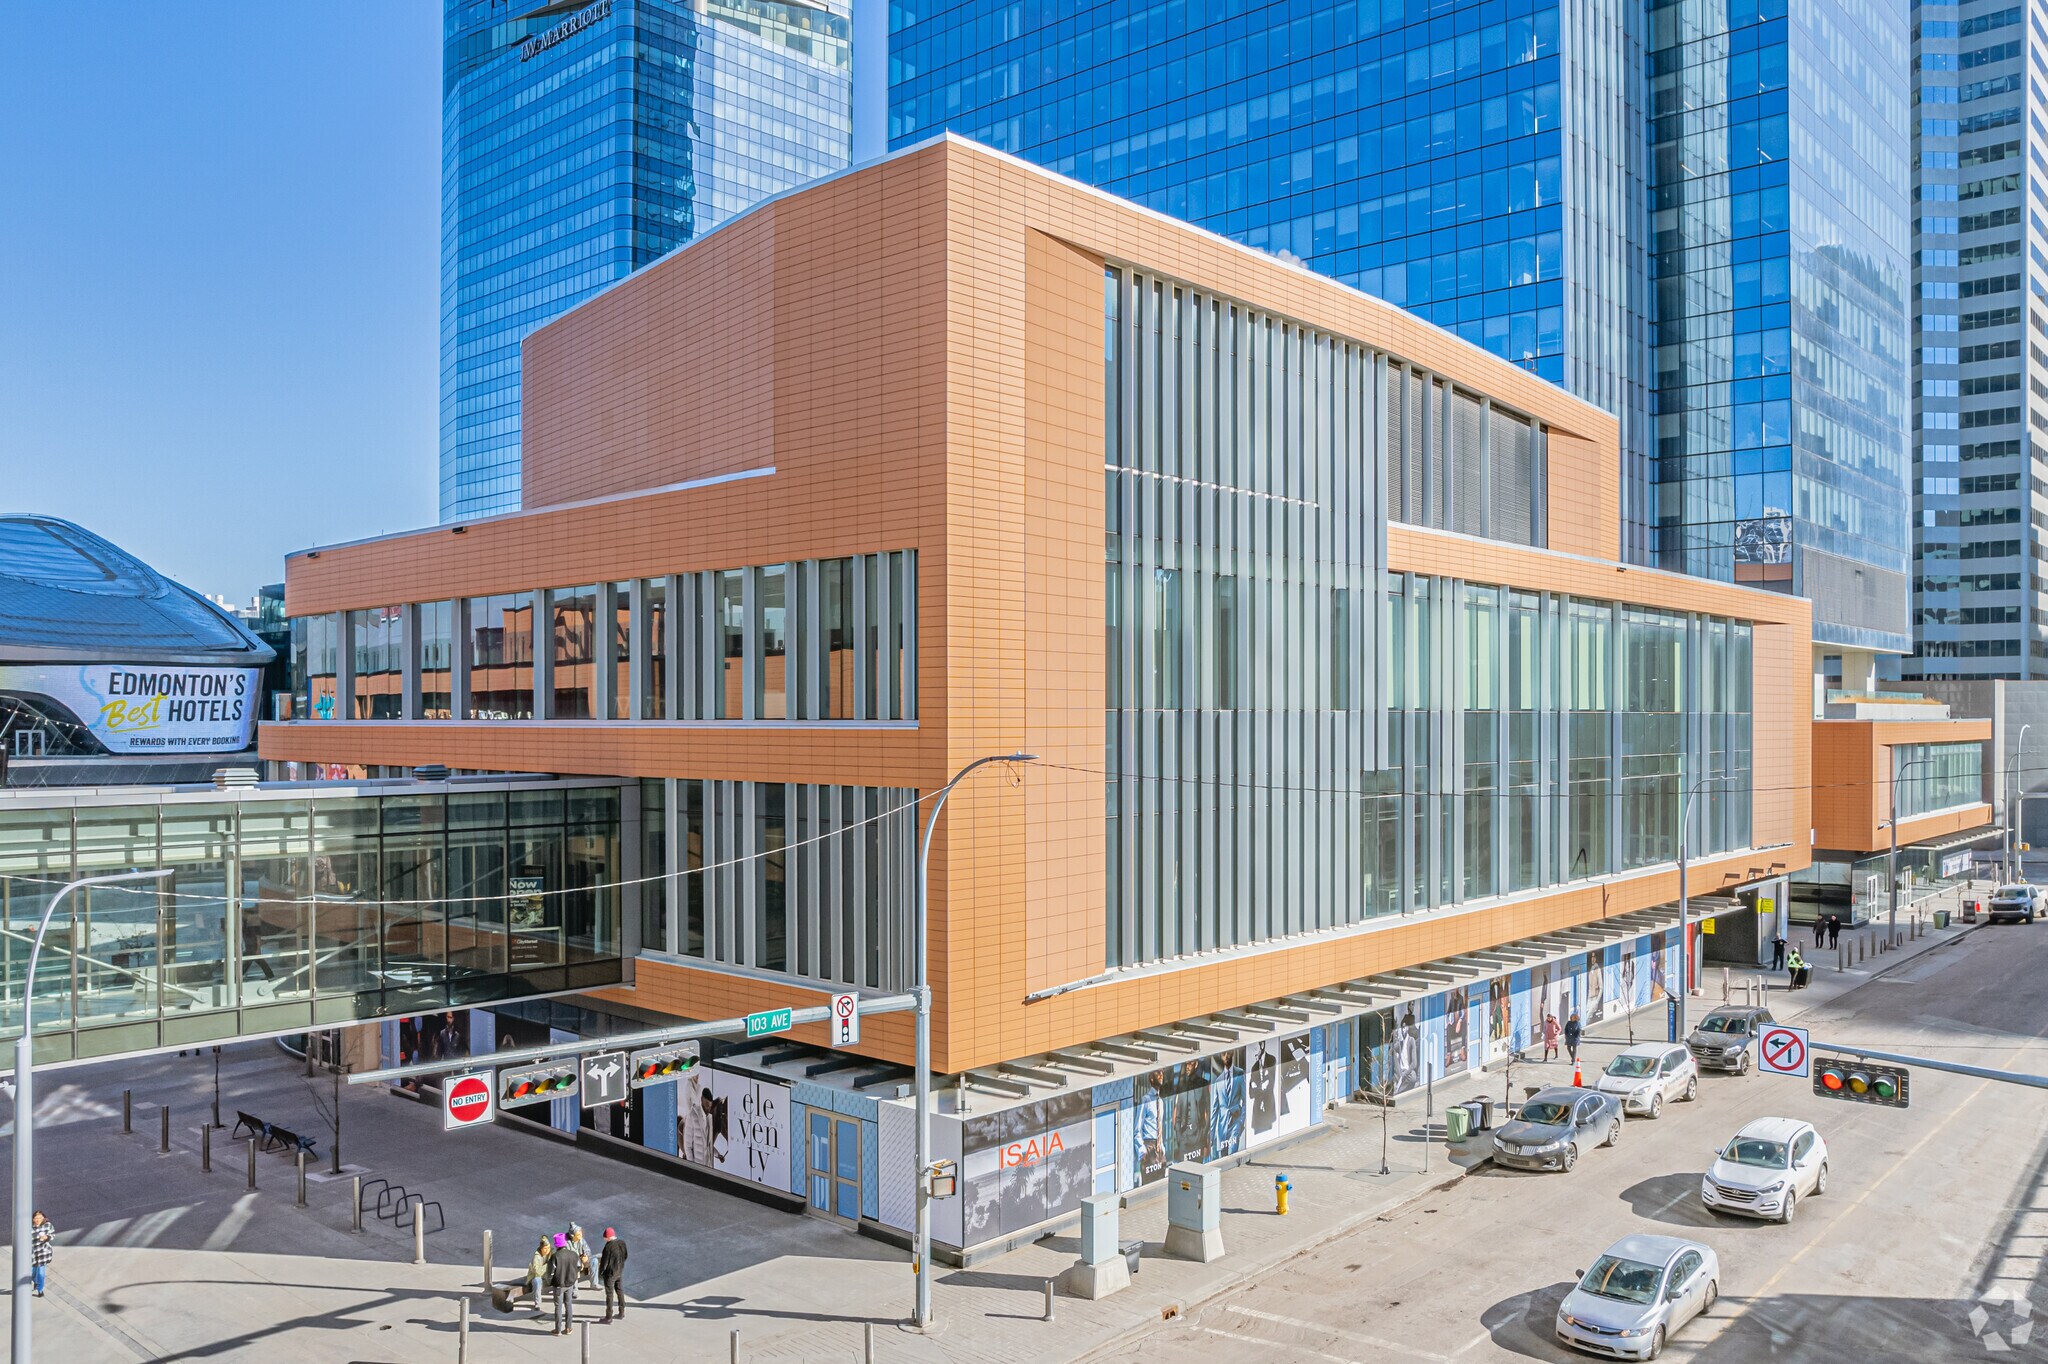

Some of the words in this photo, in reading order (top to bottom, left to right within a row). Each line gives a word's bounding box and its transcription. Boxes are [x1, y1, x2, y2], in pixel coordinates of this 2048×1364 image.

[540, 0, 609, 48] MARRIOTT
[108, 672, 246, 697] EDMONTON'S
[101, 692, 168, 730] Best
[168, 699, 243, 722] HOTELS
[129, 737, 166, 746] REWARDS
[167, 737, 186, 746] WITH
[188, 737, 211, 746] EVERY
[211, 736, 240, 746] BOOKING
[510, 880, 537, 889] Now
[751, 1016, 767, 1032] 103
[771, 1013, 788, 1029] AVE
[453, 1098, 463, 1106] NO
[465, 1093, 486, 1104] ENTRY
[743, 1083, 775, 1121] ele
[738, 1118, 779, 1149] ven
[1220, 1137, 1237, 1149] ETON
[1000, 1131, 1065, 1169] ISAIA
[1183, 1149, 1201, 1161] ETON
[1145, 1162, 1162, 1174] ETON
